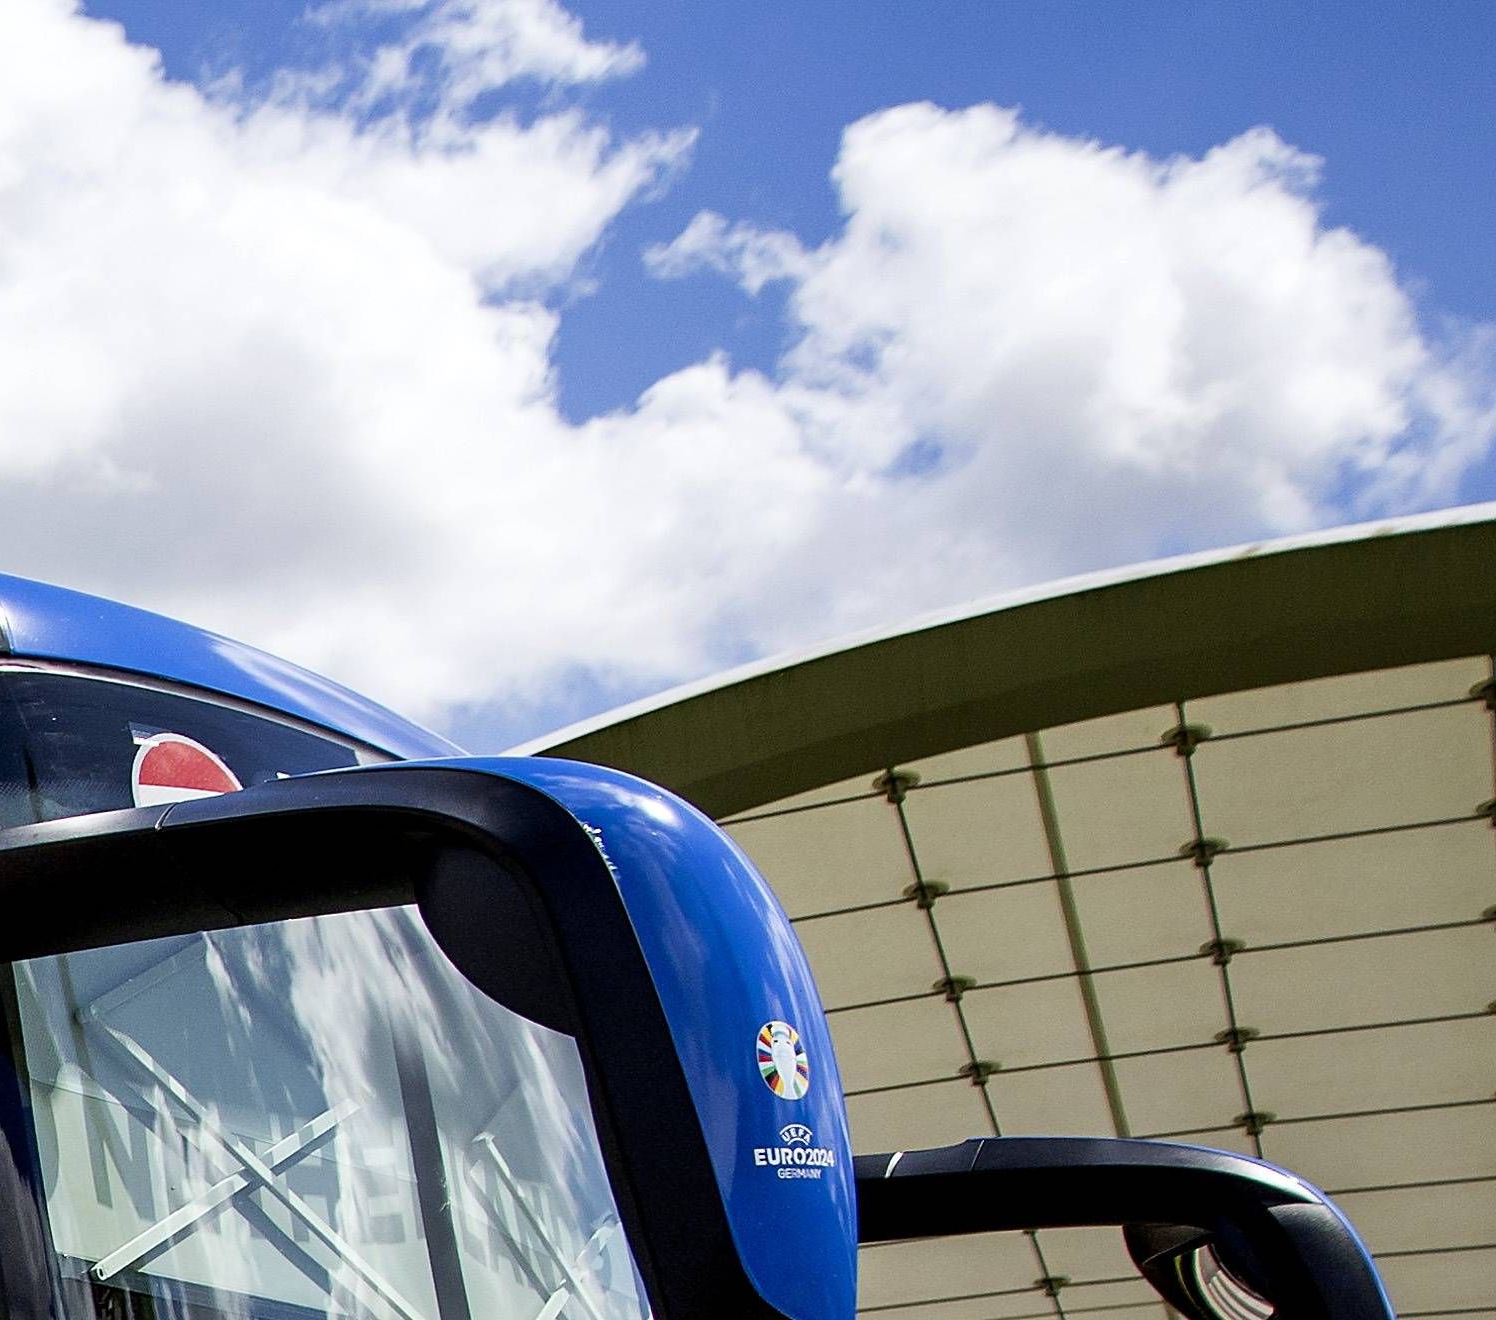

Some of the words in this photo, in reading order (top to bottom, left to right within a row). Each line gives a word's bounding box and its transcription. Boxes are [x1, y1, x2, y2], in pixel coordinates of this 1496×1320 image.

[781, 1127, 811, 1143] UEFA
[753, 1147, 835, 1168] EURO2024
[777, 1168, 822, 1179] GERMANY
